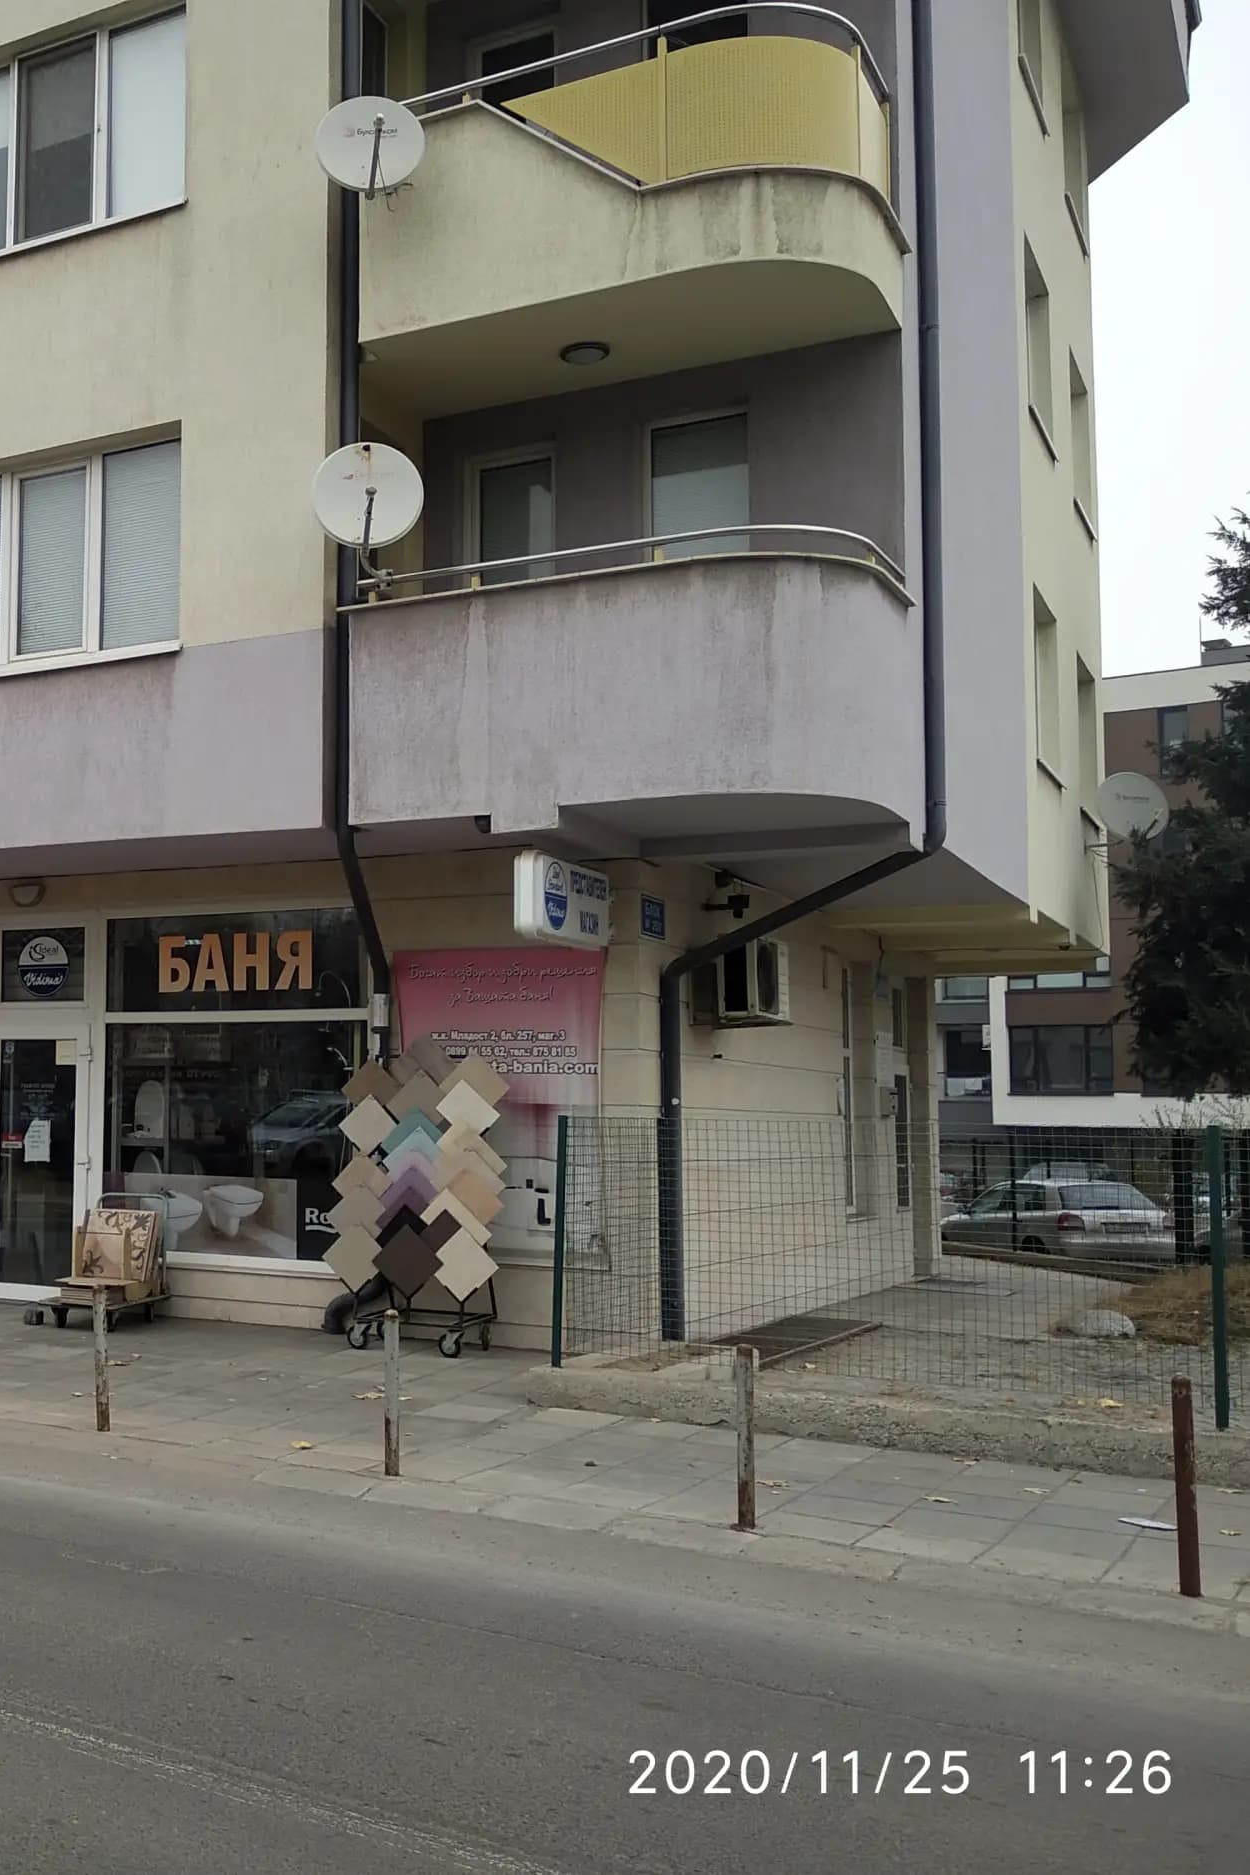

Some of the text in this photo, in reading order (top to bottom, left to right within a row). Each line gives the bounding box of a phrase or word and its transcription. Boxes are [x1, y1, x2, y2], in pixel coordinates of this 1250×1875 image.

[158, 930, 313, 993] БАНЯ
[462, 987, 517, 1004] Вашата
[450, 1030, 489, 1041] Младост
[500, 1030, 514, 1041] бл.
[558, 1031, 566, 1040] 3
[491, 1060, 599, 1075] ta-bania.com
[304, 1207, 334, 1225] Ro
